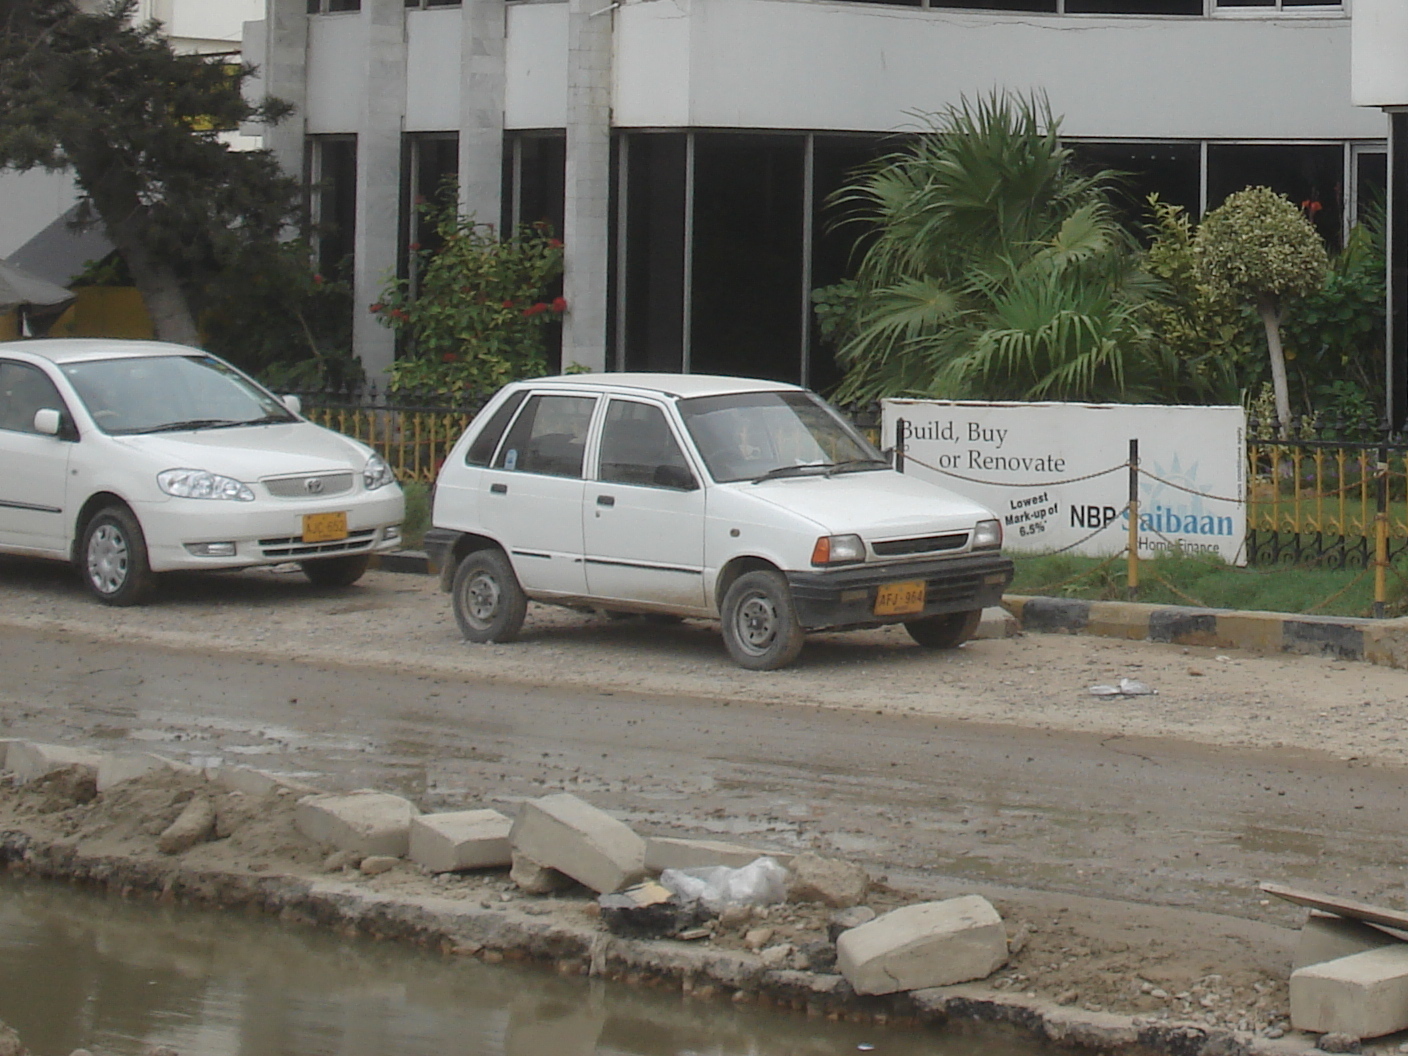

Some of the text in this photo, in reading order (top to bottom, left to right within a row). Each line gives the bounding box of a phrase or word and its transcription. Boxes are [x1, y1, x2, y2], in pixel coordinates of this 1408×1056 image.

[902, 420, 1009, 449] Build, Buy
[939, 449, 1066, 473] or Renovate
[1010, 491, 1049, 510] Lowest
[1004, 502, 1059, 526] Mark-up of
[1070, 504, 1116, 529] NBP
